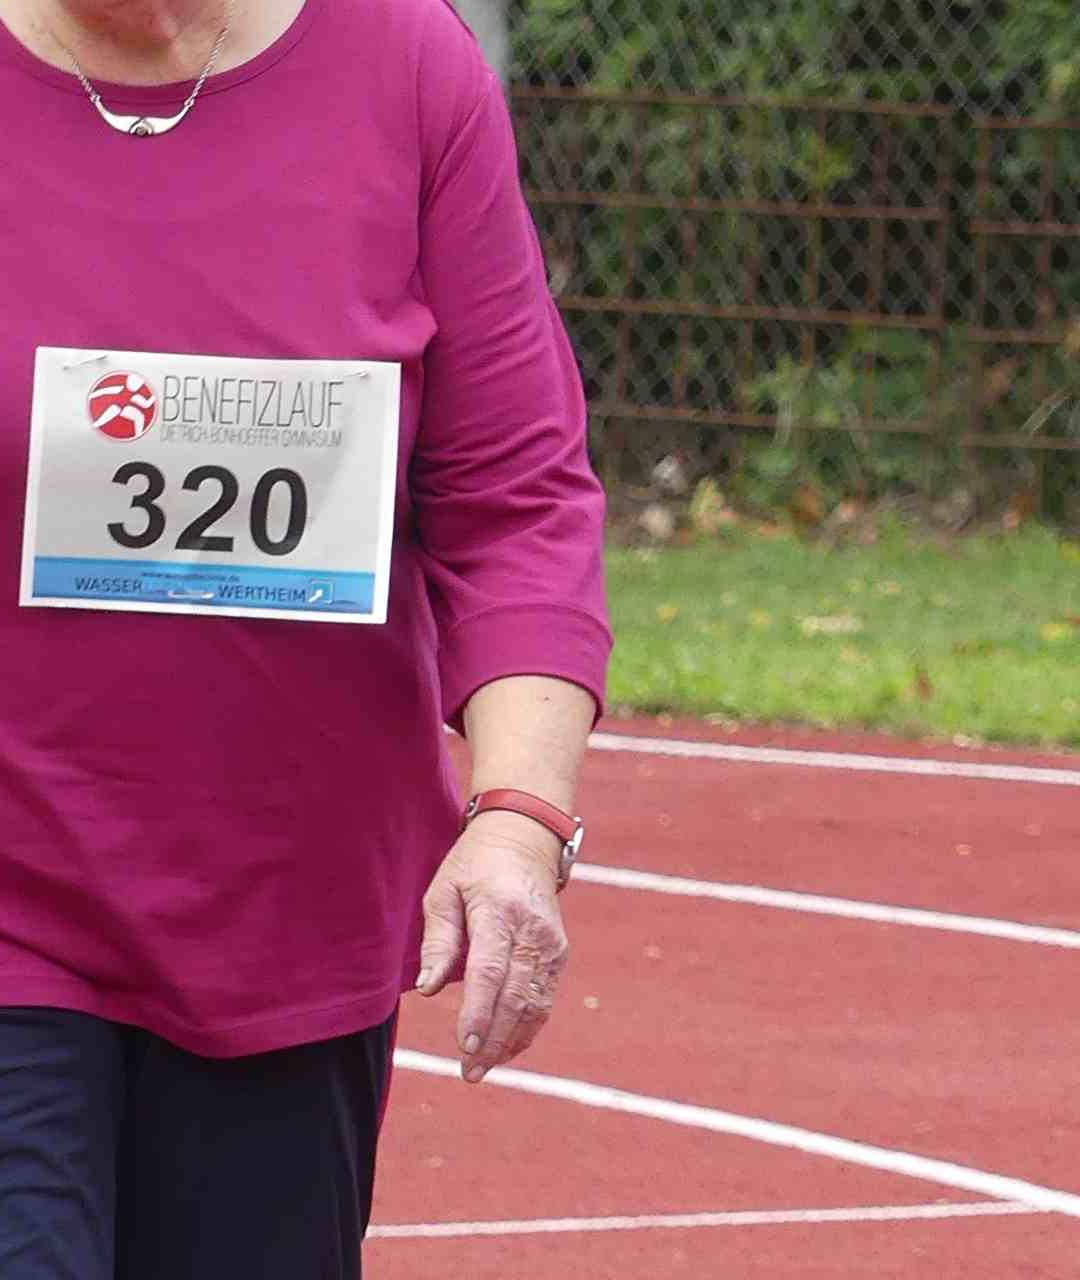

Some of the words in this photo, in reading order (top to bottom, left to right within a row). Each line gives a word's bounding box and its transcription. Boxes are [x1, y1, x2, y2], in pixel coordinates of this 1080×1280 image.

[162, 374, 344, 429] BENEFIZLAUF
[106, 460, 309, 557] 320
[73, 576, 143, 595] WASSER
[218, 584, 308, 604] WERTHEIM
